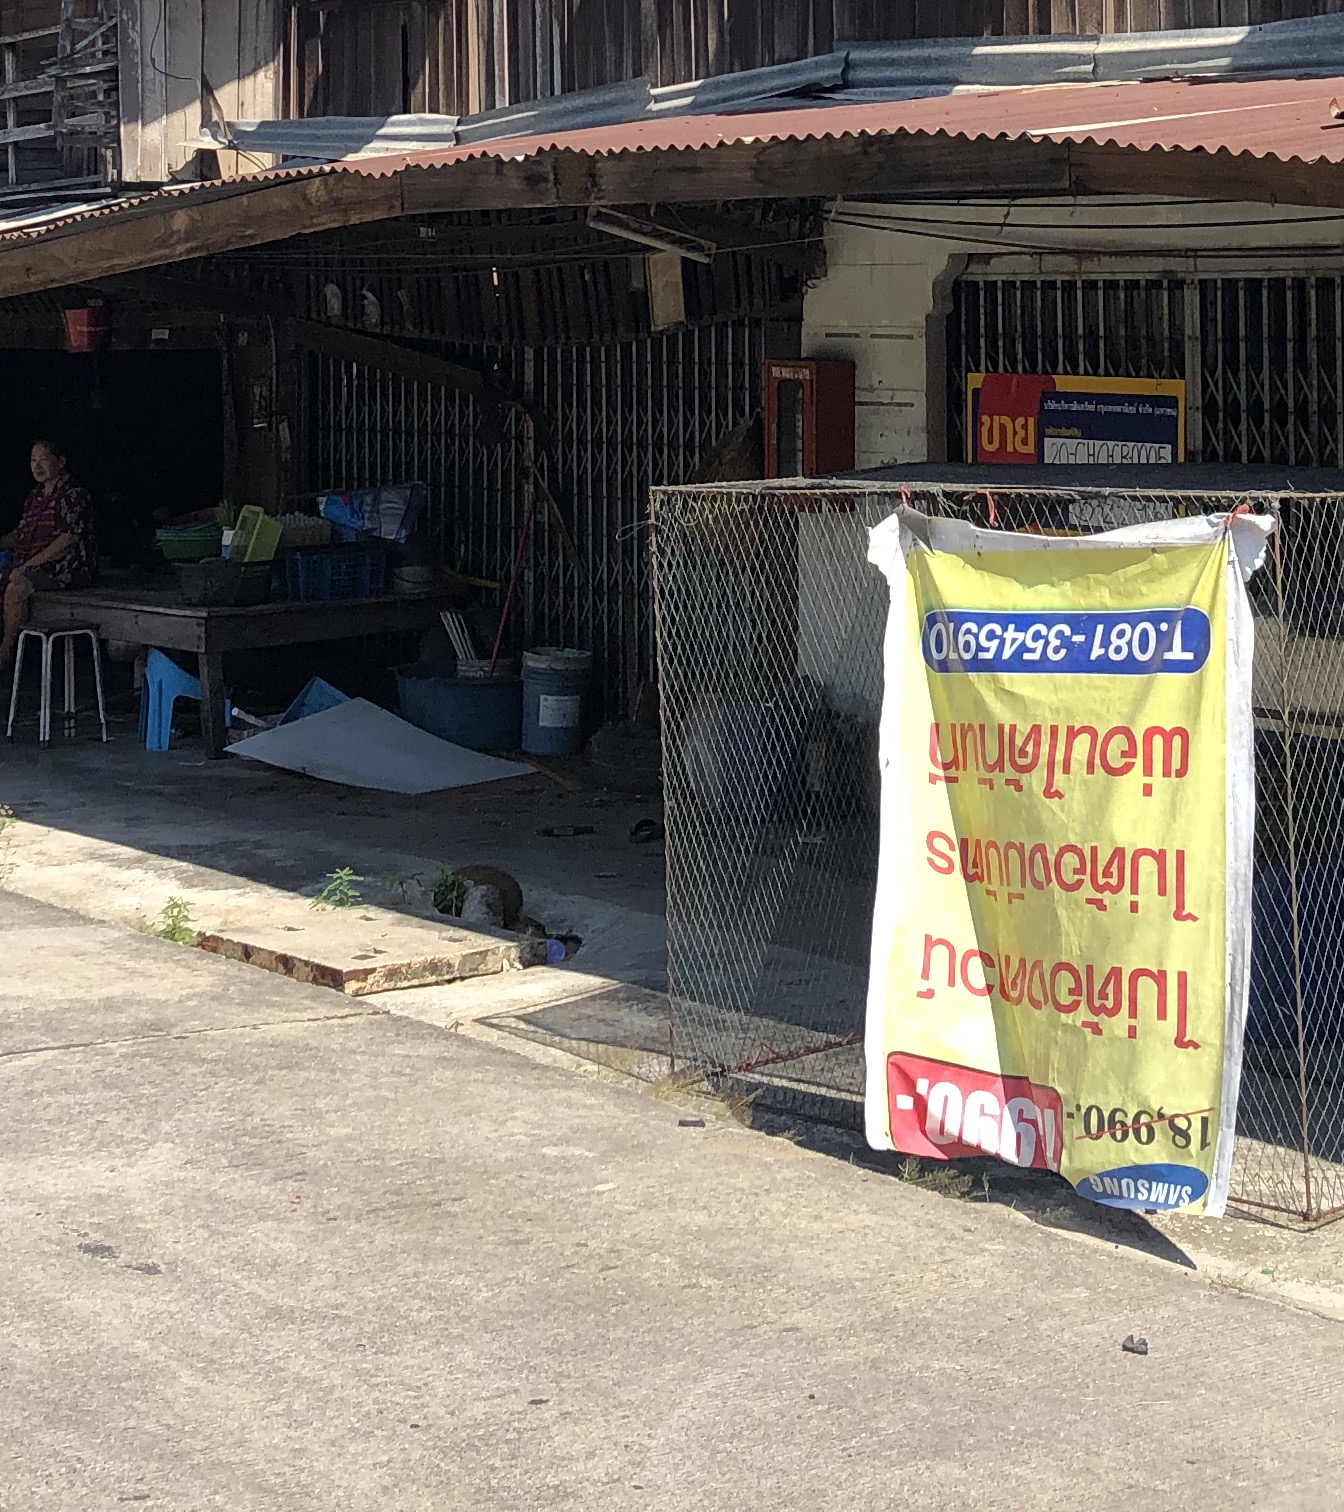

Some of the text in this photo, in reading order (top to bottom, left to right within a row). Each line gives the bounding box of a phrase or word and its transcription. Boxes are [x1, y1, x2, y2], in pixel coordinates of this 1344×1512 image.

[981, 414, 1035, 454] ขาย
[928, 721, 1190, 800] ผ่อนได้ทันที
[925, 830, 1200, 923] ไม่ต้องมีบัตร
[1091, 1173, 1193, 1207] SAMSUNG
